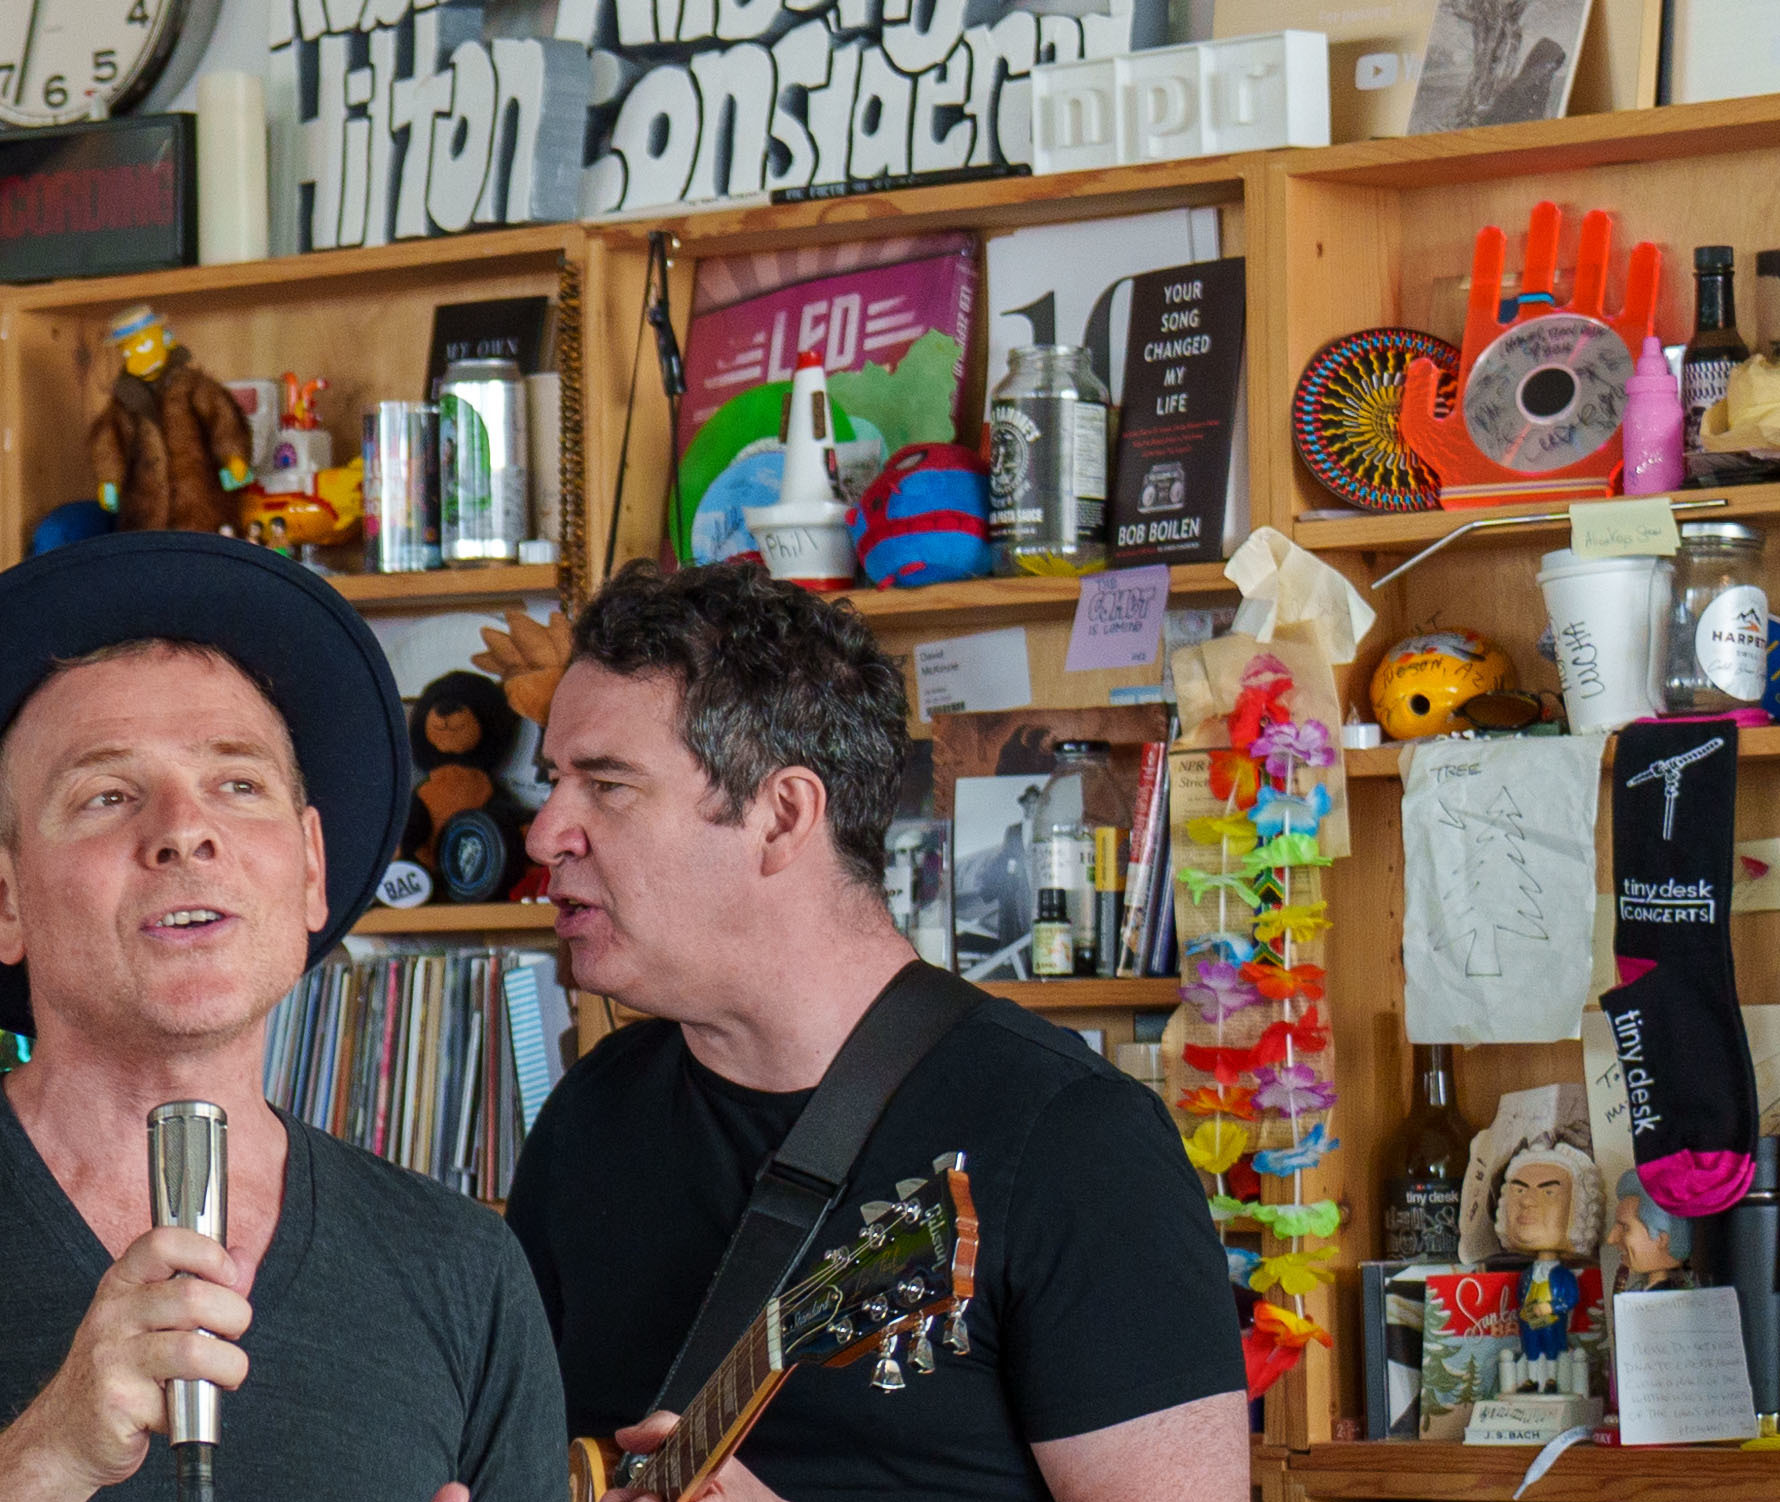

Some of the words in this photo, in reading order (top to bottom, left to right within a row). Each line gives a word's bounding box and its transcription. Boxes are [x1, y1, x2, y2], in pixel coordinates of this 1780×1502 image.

[1164, 281, 1203, 305] YOUR
[1160, 309, 1201, 332] SONG
[1143, 335, 1211, 363] CHANGED
[1163, 366, 1186, 386] MY
[1156, 393, 1190, 416] LIFE
[1118, 522, 1146, 546] BOB
[1148, 516, 1201, 543] BOILEN
[1429, 761, 1483, 783] TREE
[1623, 878, 1658, 902] tiny
[1659, 878, 1714, 899] desk
[1623, 905, 1710, 924] CONCERTS
[1614, 1008, 1644, 1062] tiny
[1627, 1065, 1662, 1136] desk
[1405, 1190, 1427, 1205] tiny
[1427, 1190, 1459, 1203] desk
[1509, 1430, 1540, 1440] BACH
